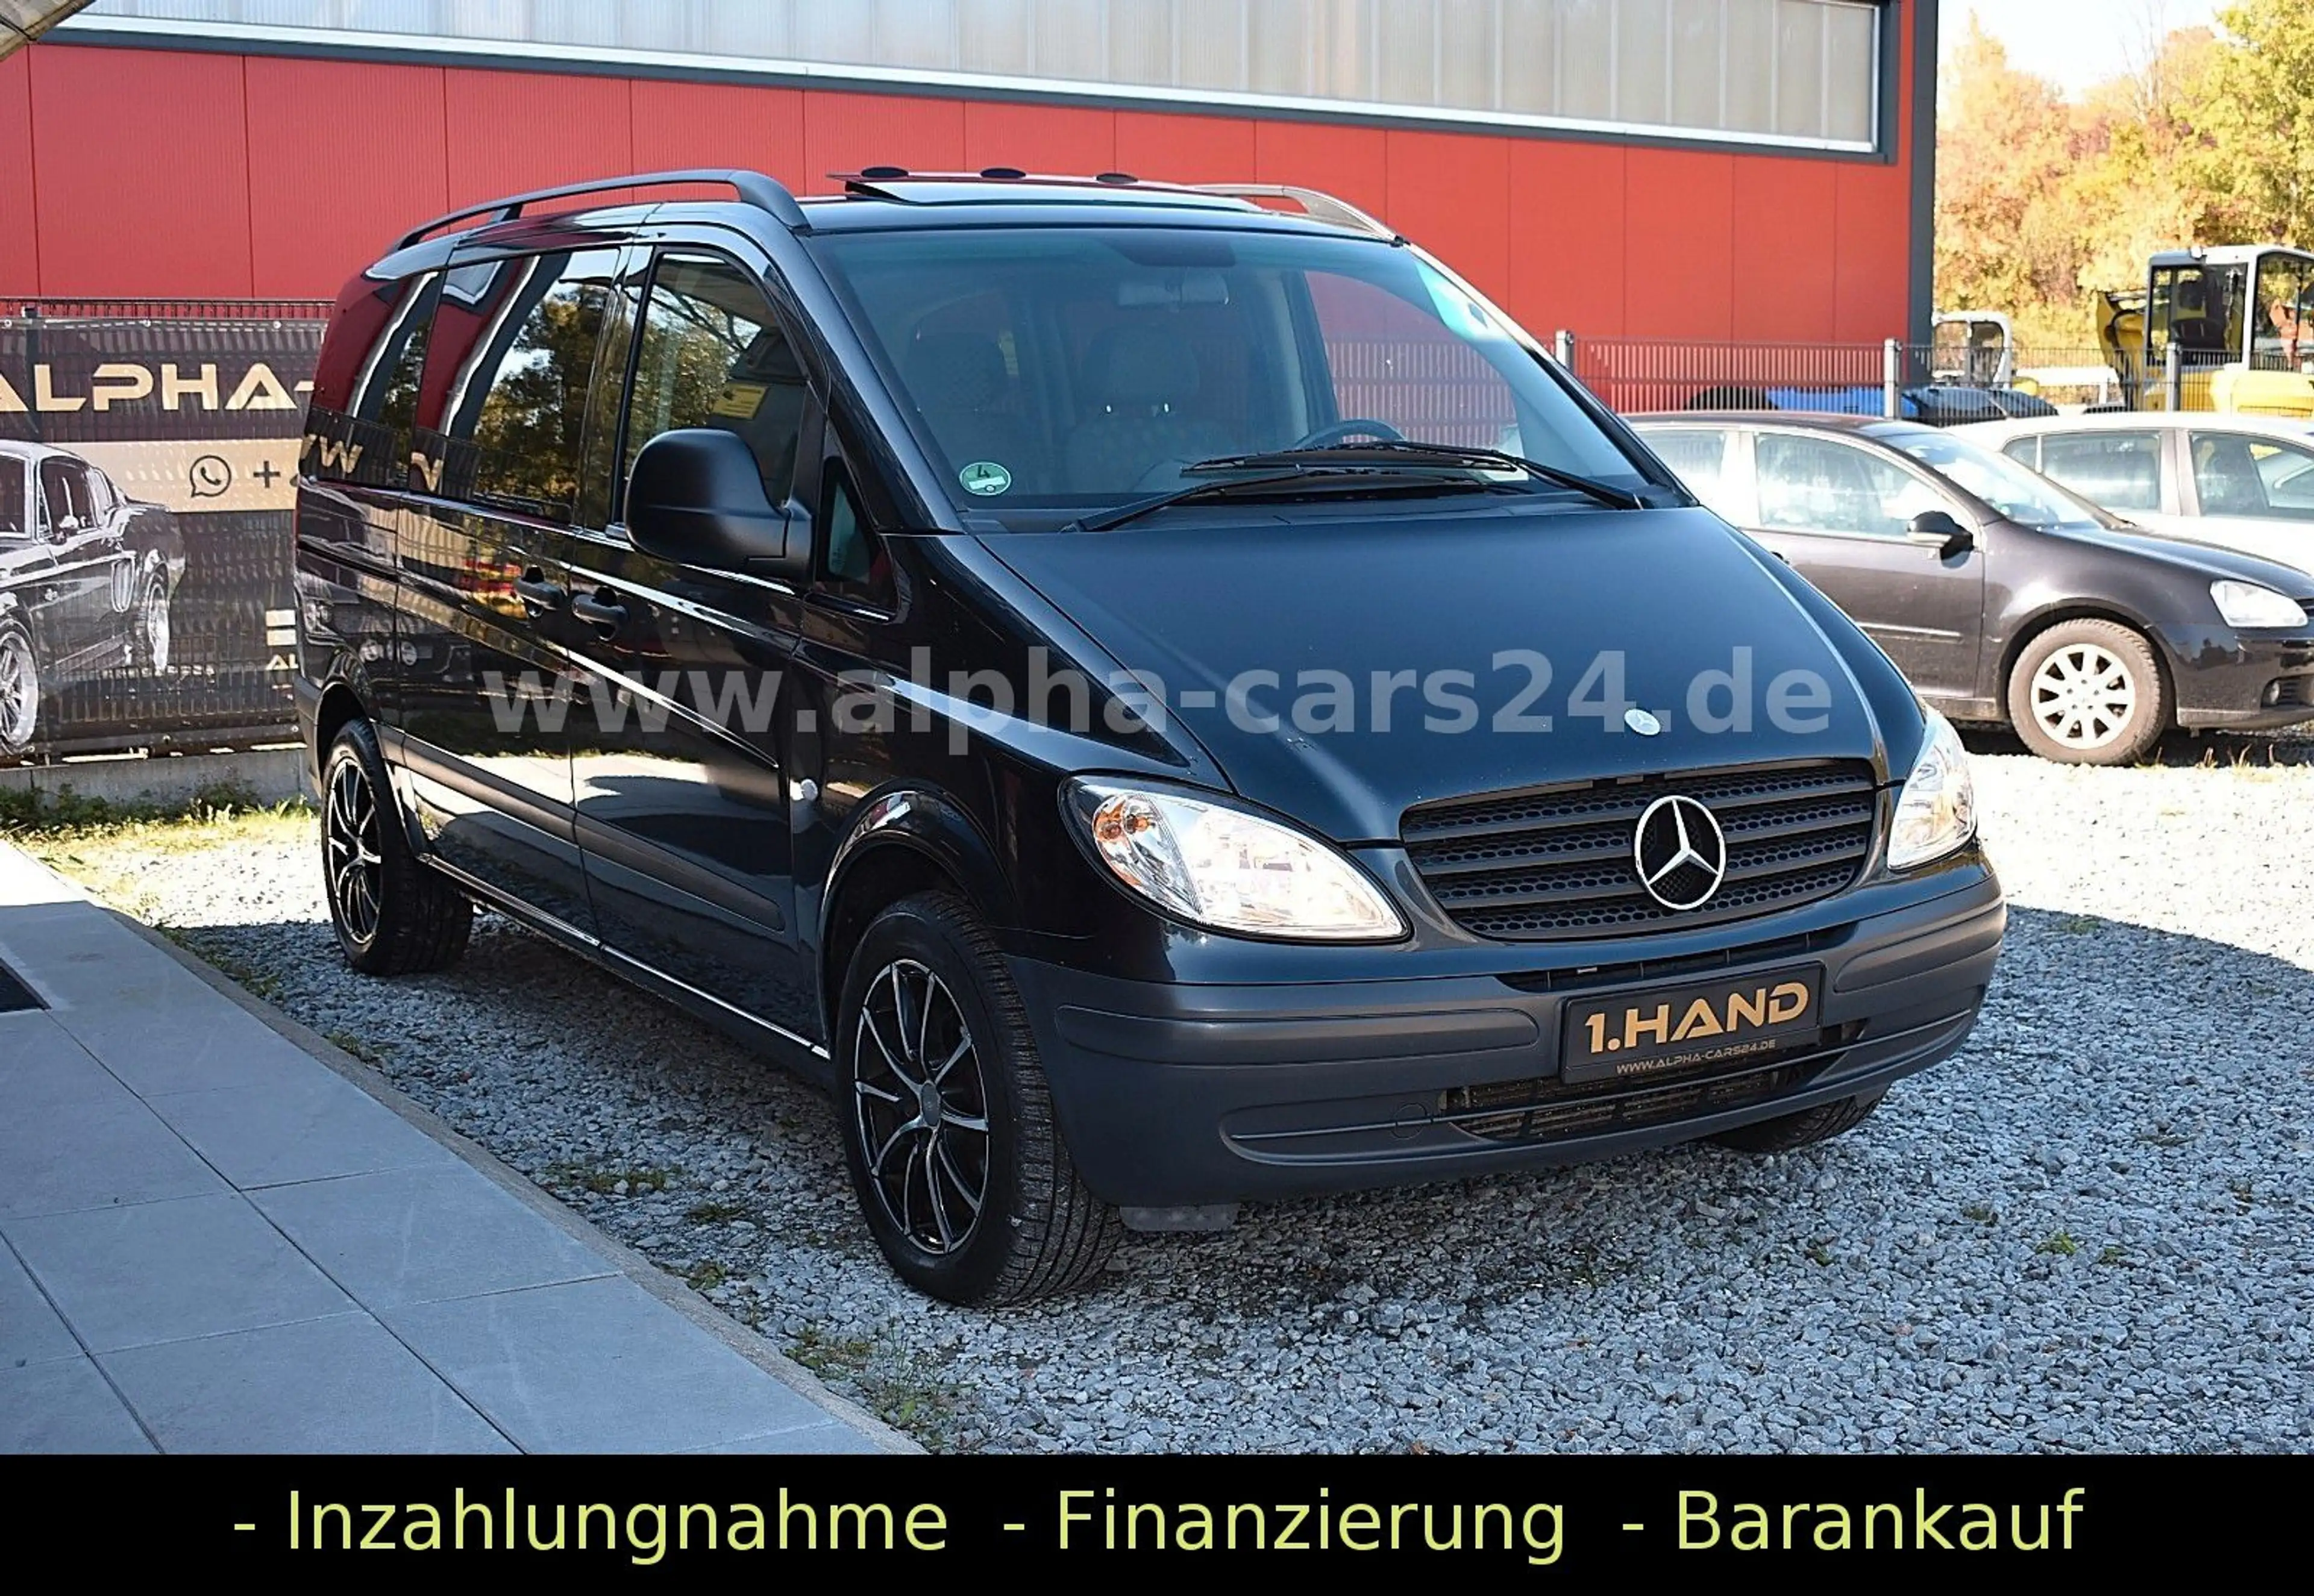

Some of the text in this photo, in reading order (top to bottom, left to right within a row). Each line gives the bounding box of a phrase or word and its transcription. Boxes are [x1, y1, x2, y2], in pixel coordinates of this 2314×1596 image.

[977, 465, 990, 478] 4
[1585, 981, 1810, 1053] 1.HAND
[1617, 1039, 1776, 1074] WWW.ALPHA-CARS24.DE
